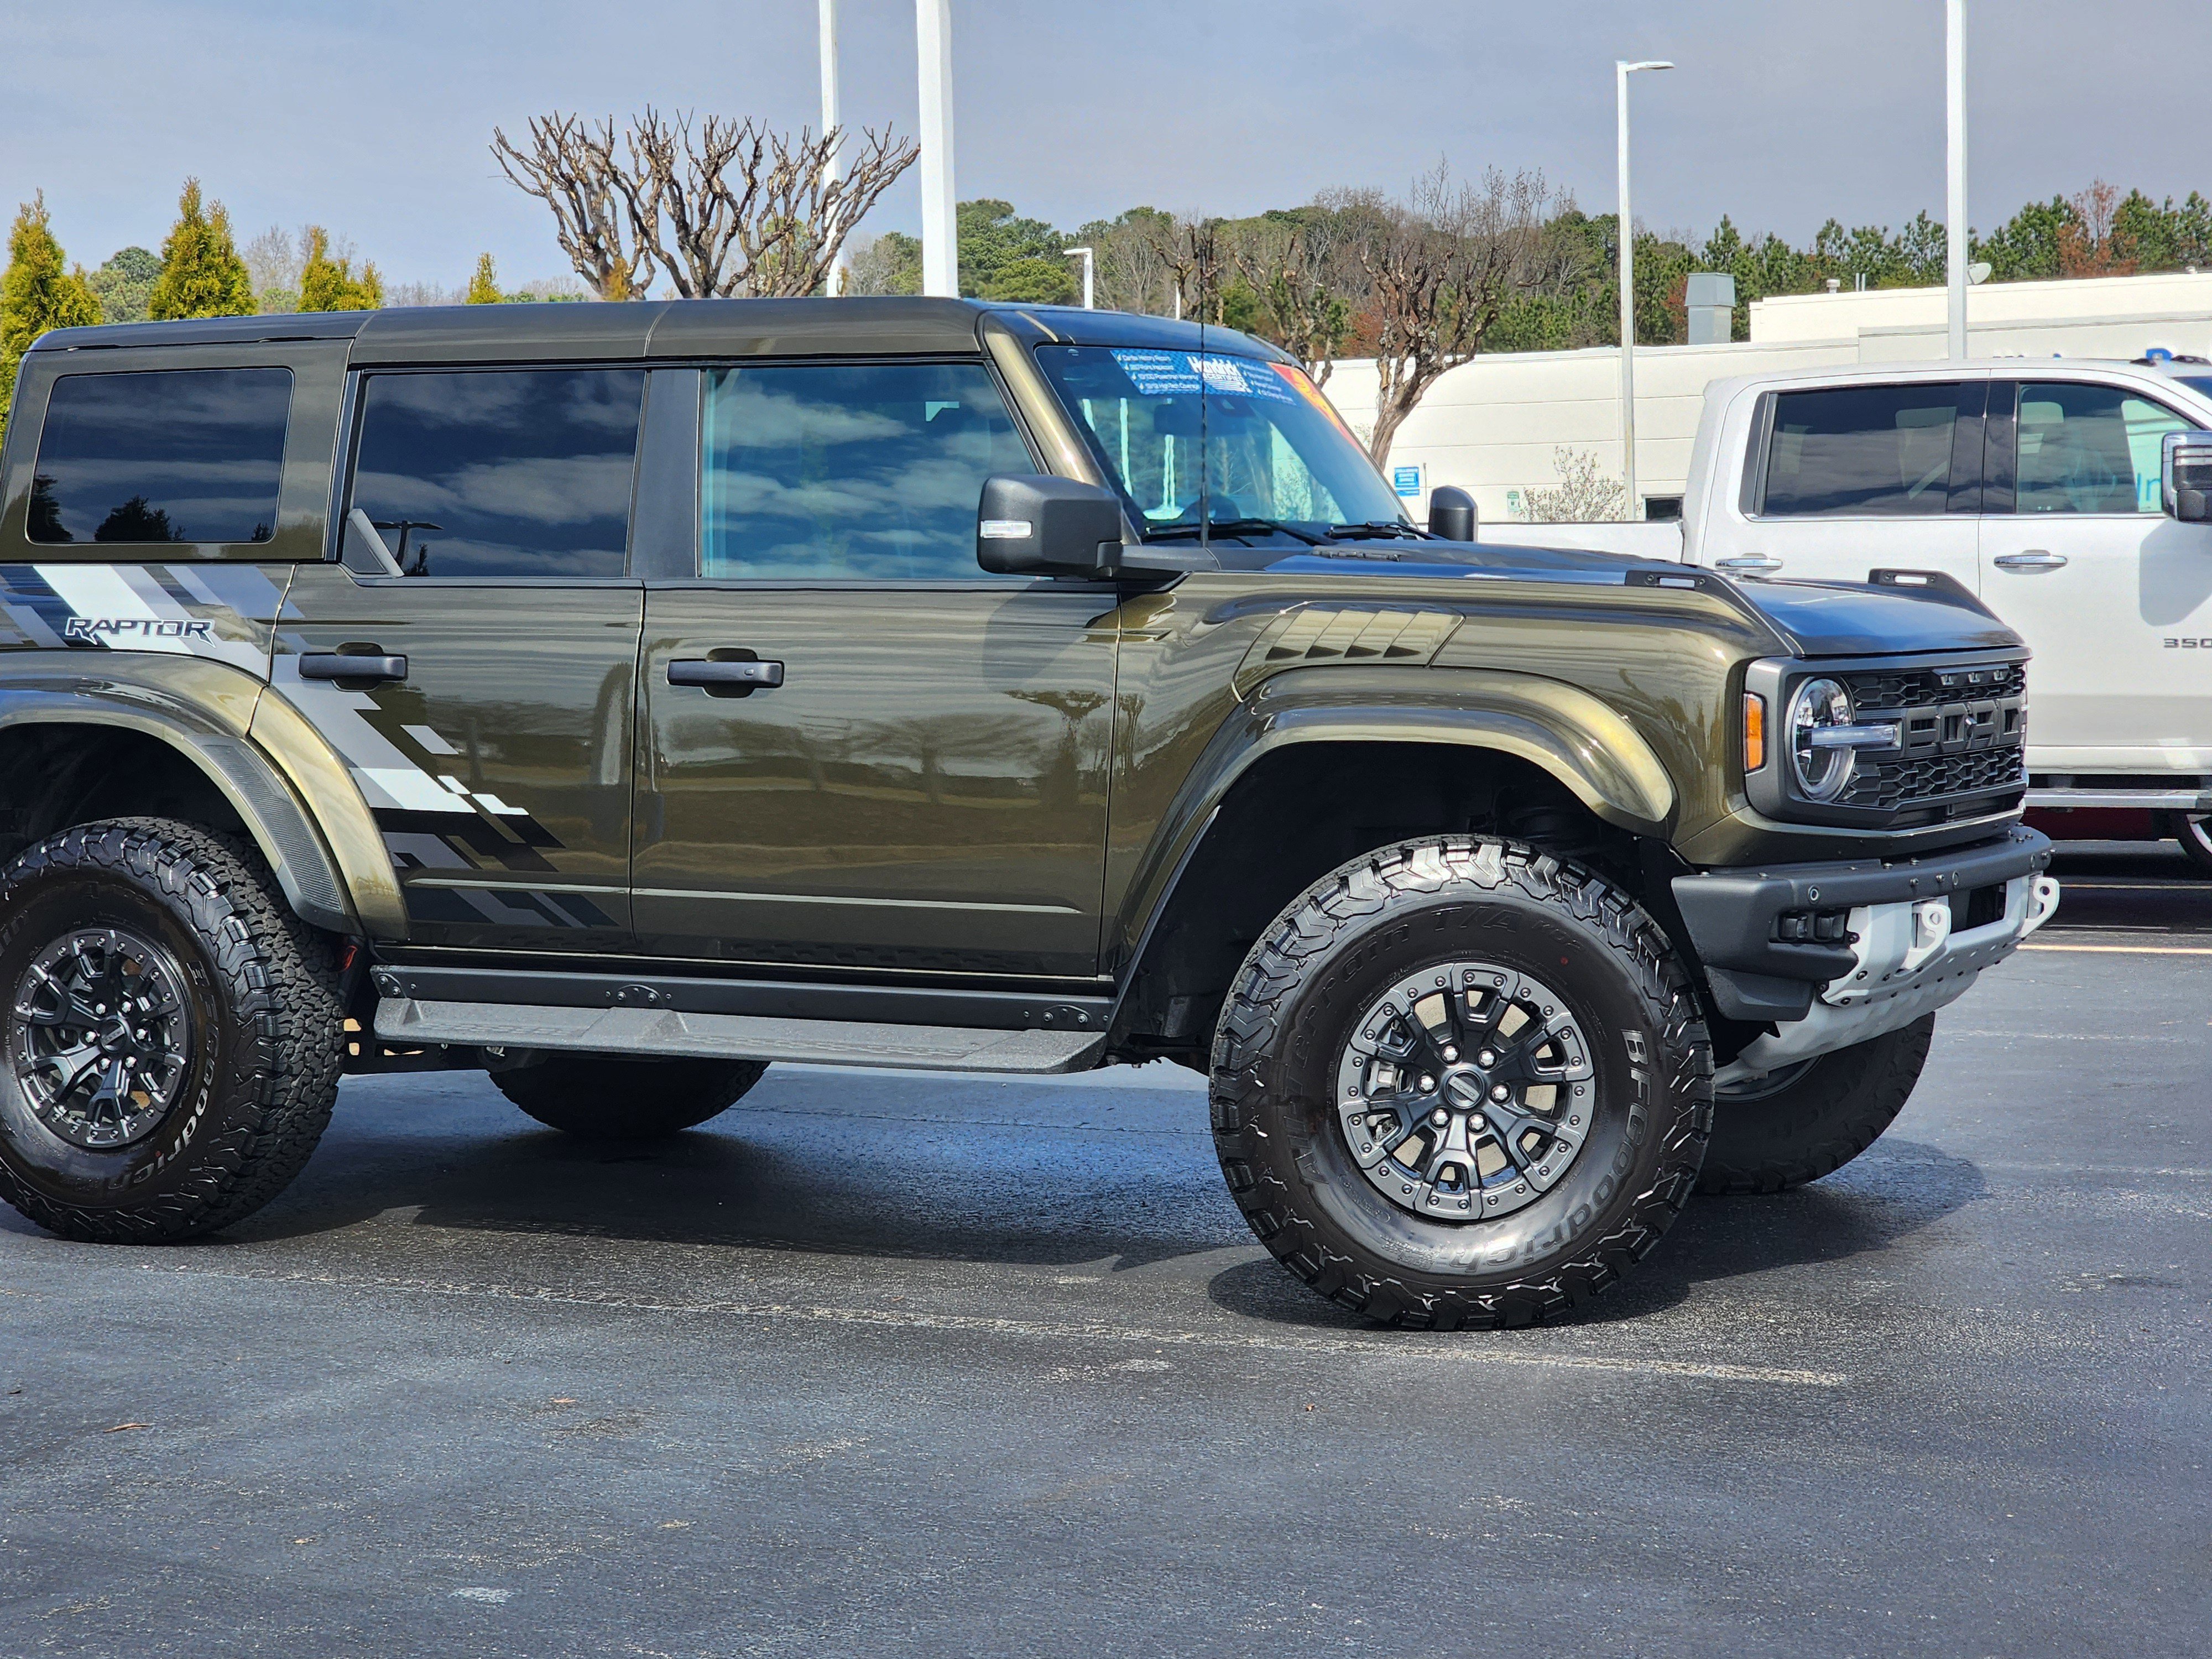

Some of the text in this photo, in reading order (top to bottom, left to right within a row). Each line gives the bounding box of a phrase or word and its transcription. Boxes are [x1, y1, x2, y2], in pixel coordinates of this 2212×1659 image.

[1207, 373, 1245, 382] CERTIFIED
[65, 617, 216, 648] RAPTOR
[2164, 638, 2212, 649] 350
[1906, 696, 2023, 756] FORD
[1431, 906, 1522, 933] T/A
[108, 960, 220, 1190] BFGoodrich
[1453, 1081, 1475, 1097] FORD
[1448, 1028, 1653, 1273] BFGoodrich
